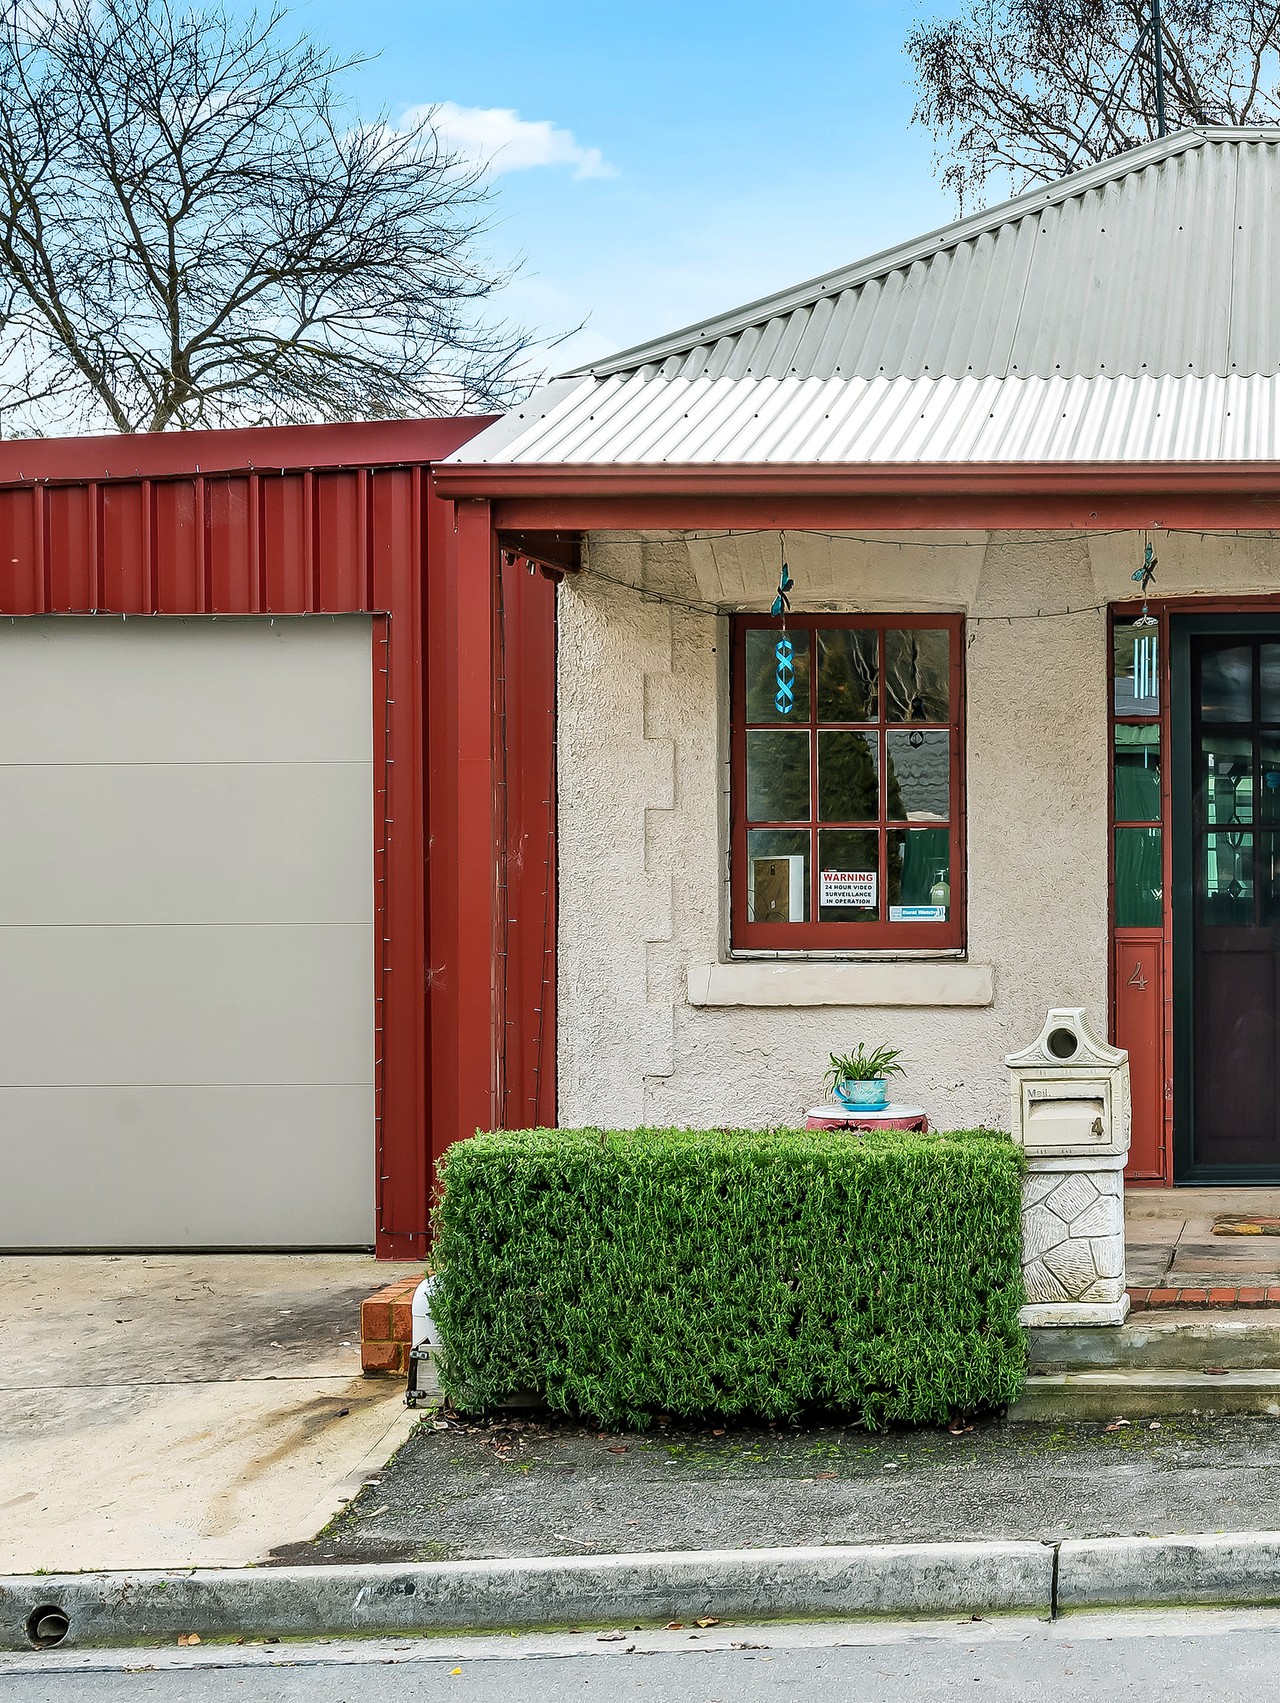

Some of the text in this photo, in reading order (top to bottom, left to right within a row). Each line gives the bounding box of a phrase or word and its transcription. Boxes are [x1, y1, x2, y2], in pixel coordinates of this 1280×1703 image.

[823, 873, 873, 882] WARNING
[1127, 961, 1149, 991] 4
[1091, 1117, 1104, 1136] 4
